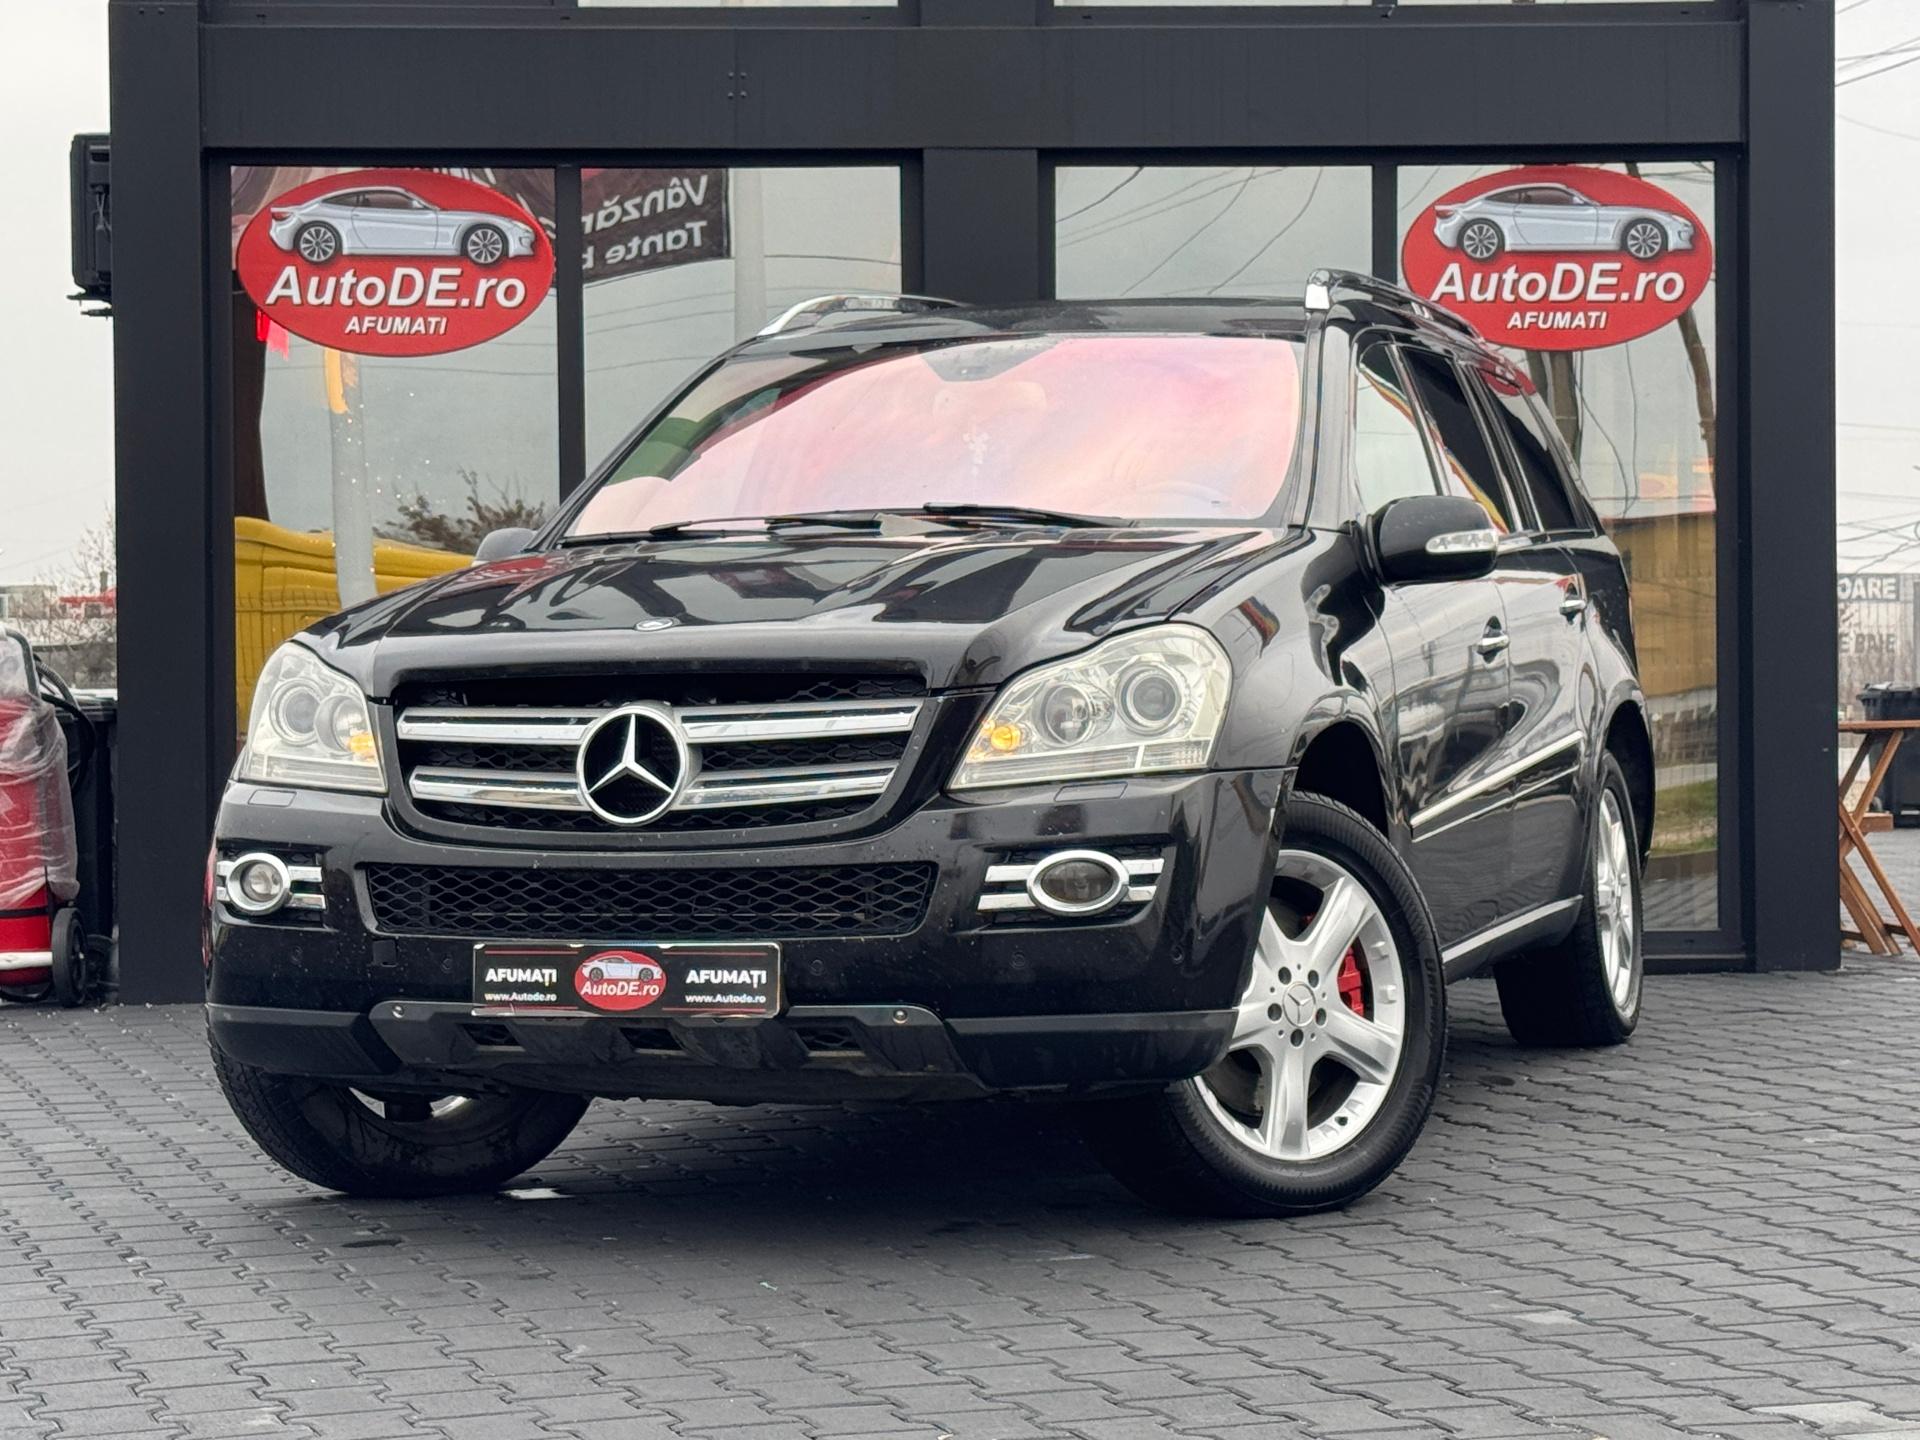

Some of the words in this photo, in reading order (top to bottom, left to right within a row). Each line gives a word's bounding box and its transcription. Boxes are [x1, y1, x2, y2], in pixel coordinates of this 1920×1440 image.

[265, 265, 526, 308] AutoDE.ro
[1430, 262, 1686, 303] AutoDE.ro
[345, 316, 447, 335] AFUMATI
[1506, 311, 1607, 329] AFUMATI
[484, 991, 557, 1003] www.Autode.ro
[580, 979, 660, 998] AutoDE.ro
[685, 992, 767, 1004] www.Autode.ro
